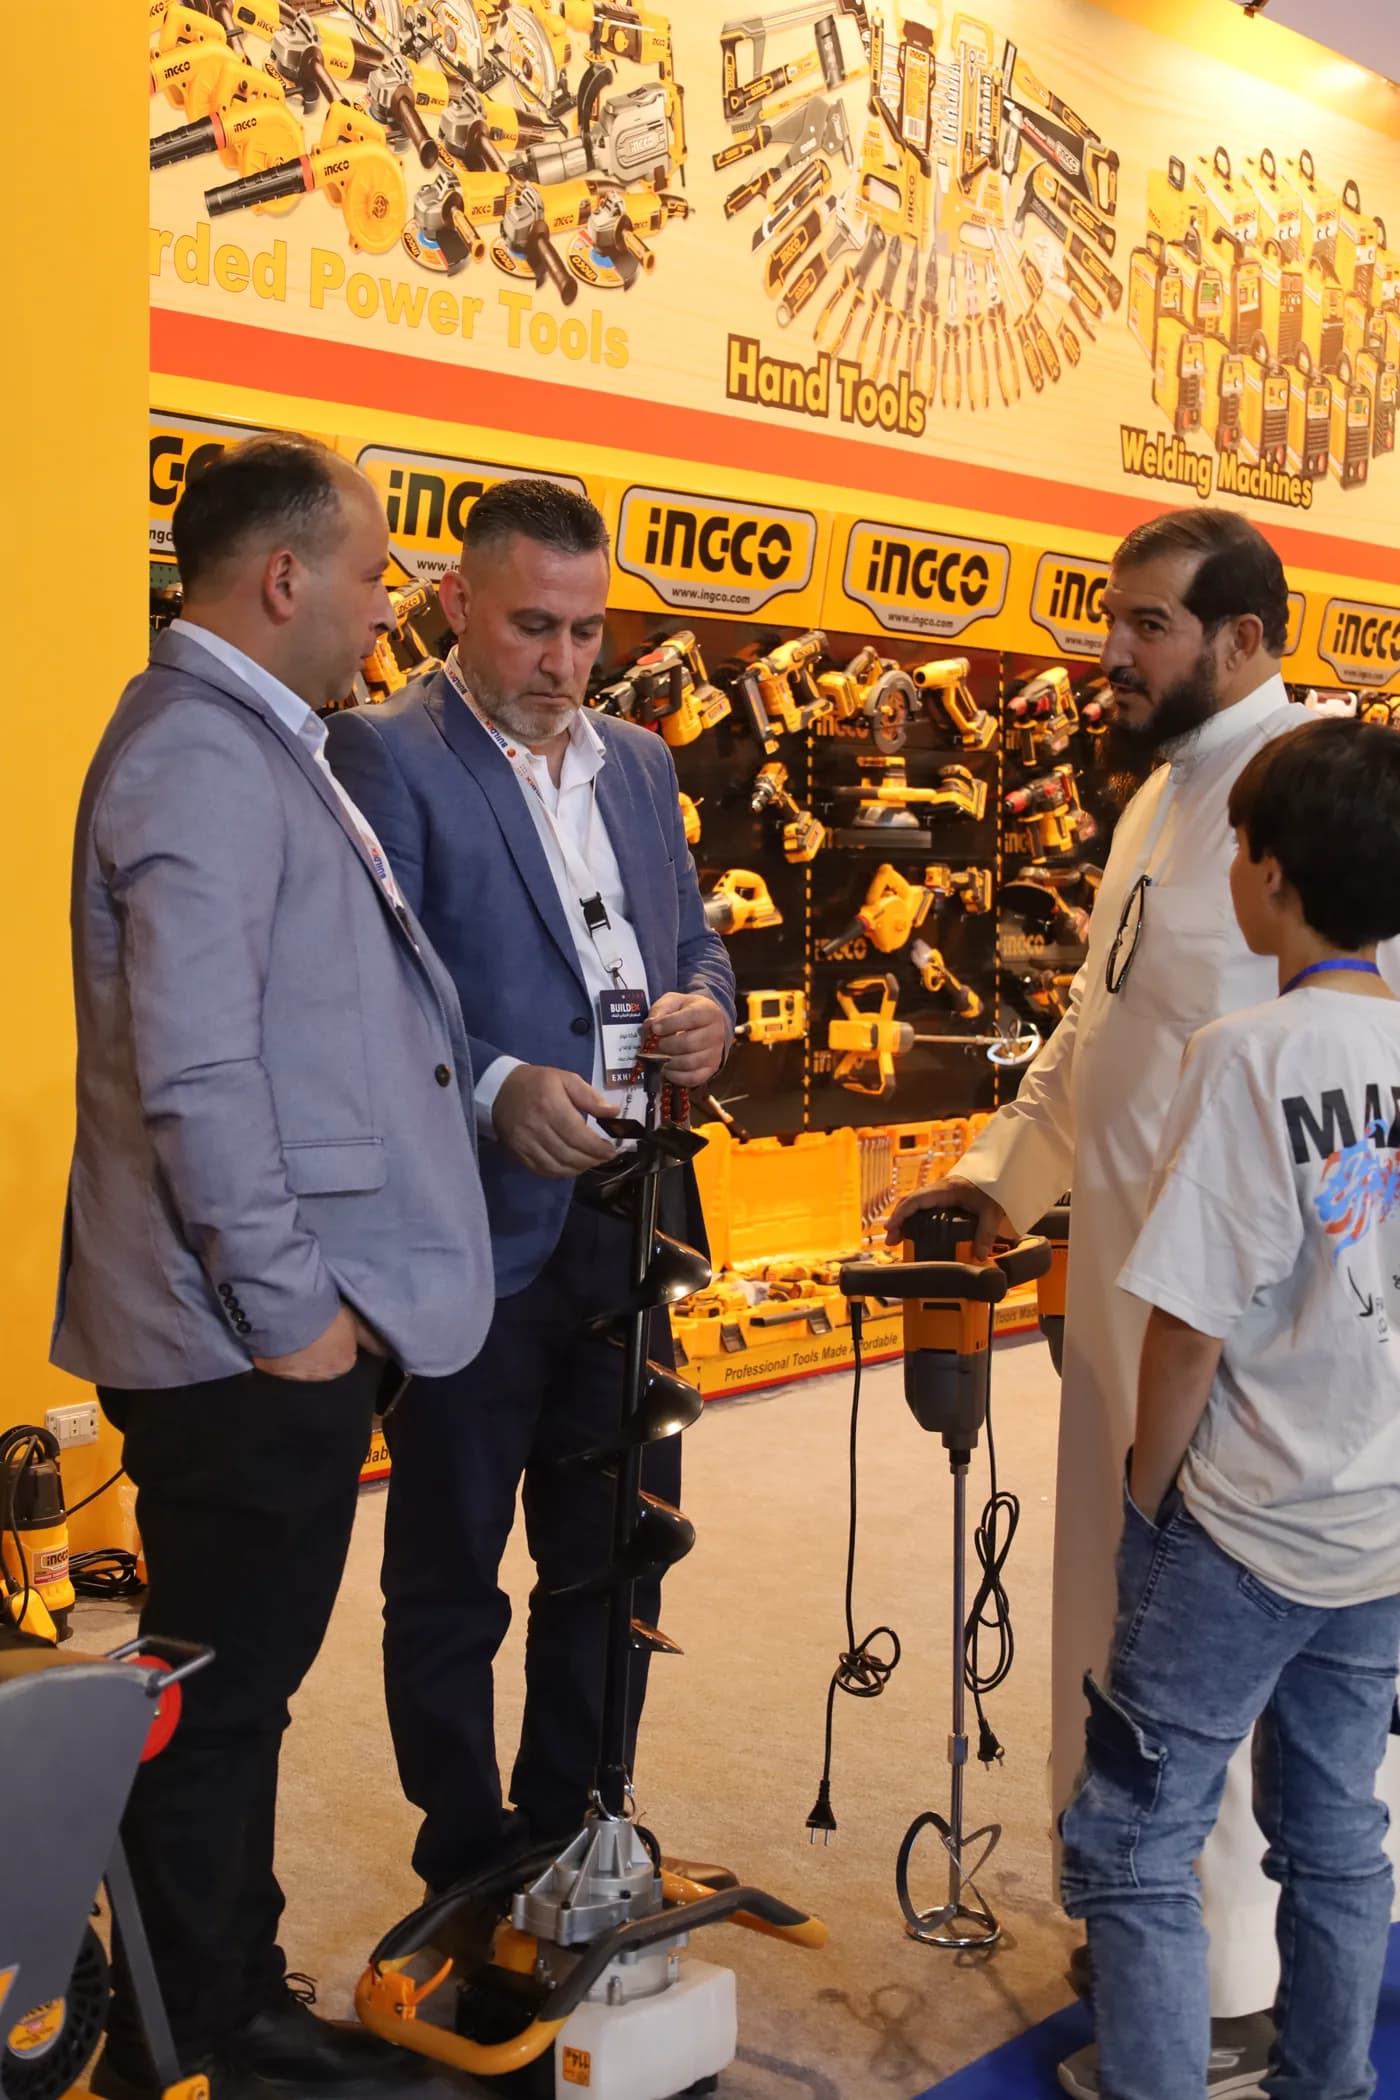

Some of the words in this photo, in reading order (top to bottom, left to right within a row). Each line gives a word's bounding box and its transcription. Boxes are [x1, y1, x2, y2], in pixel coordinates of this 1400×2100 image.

[310, 247, 485, 339] Power
[498, 288, 630, 369] Tools
[727, 334, 831, 417] Hand
[837, 359, 927, 437] Tools
[1120, 424, 1213, 498] Welding
[1217, 451, 1314, 509] Machines
[671, 586, 751, 607] www.ingco.com
[887, 610, 955, 630] www.ingco.com
[724, 1356, 790, 1382] Professional
[792, 1351, 819, 1367] Tools
[821, 1342, 848, 1361] Made
[849, 1332, 898, 1354] Afordable
